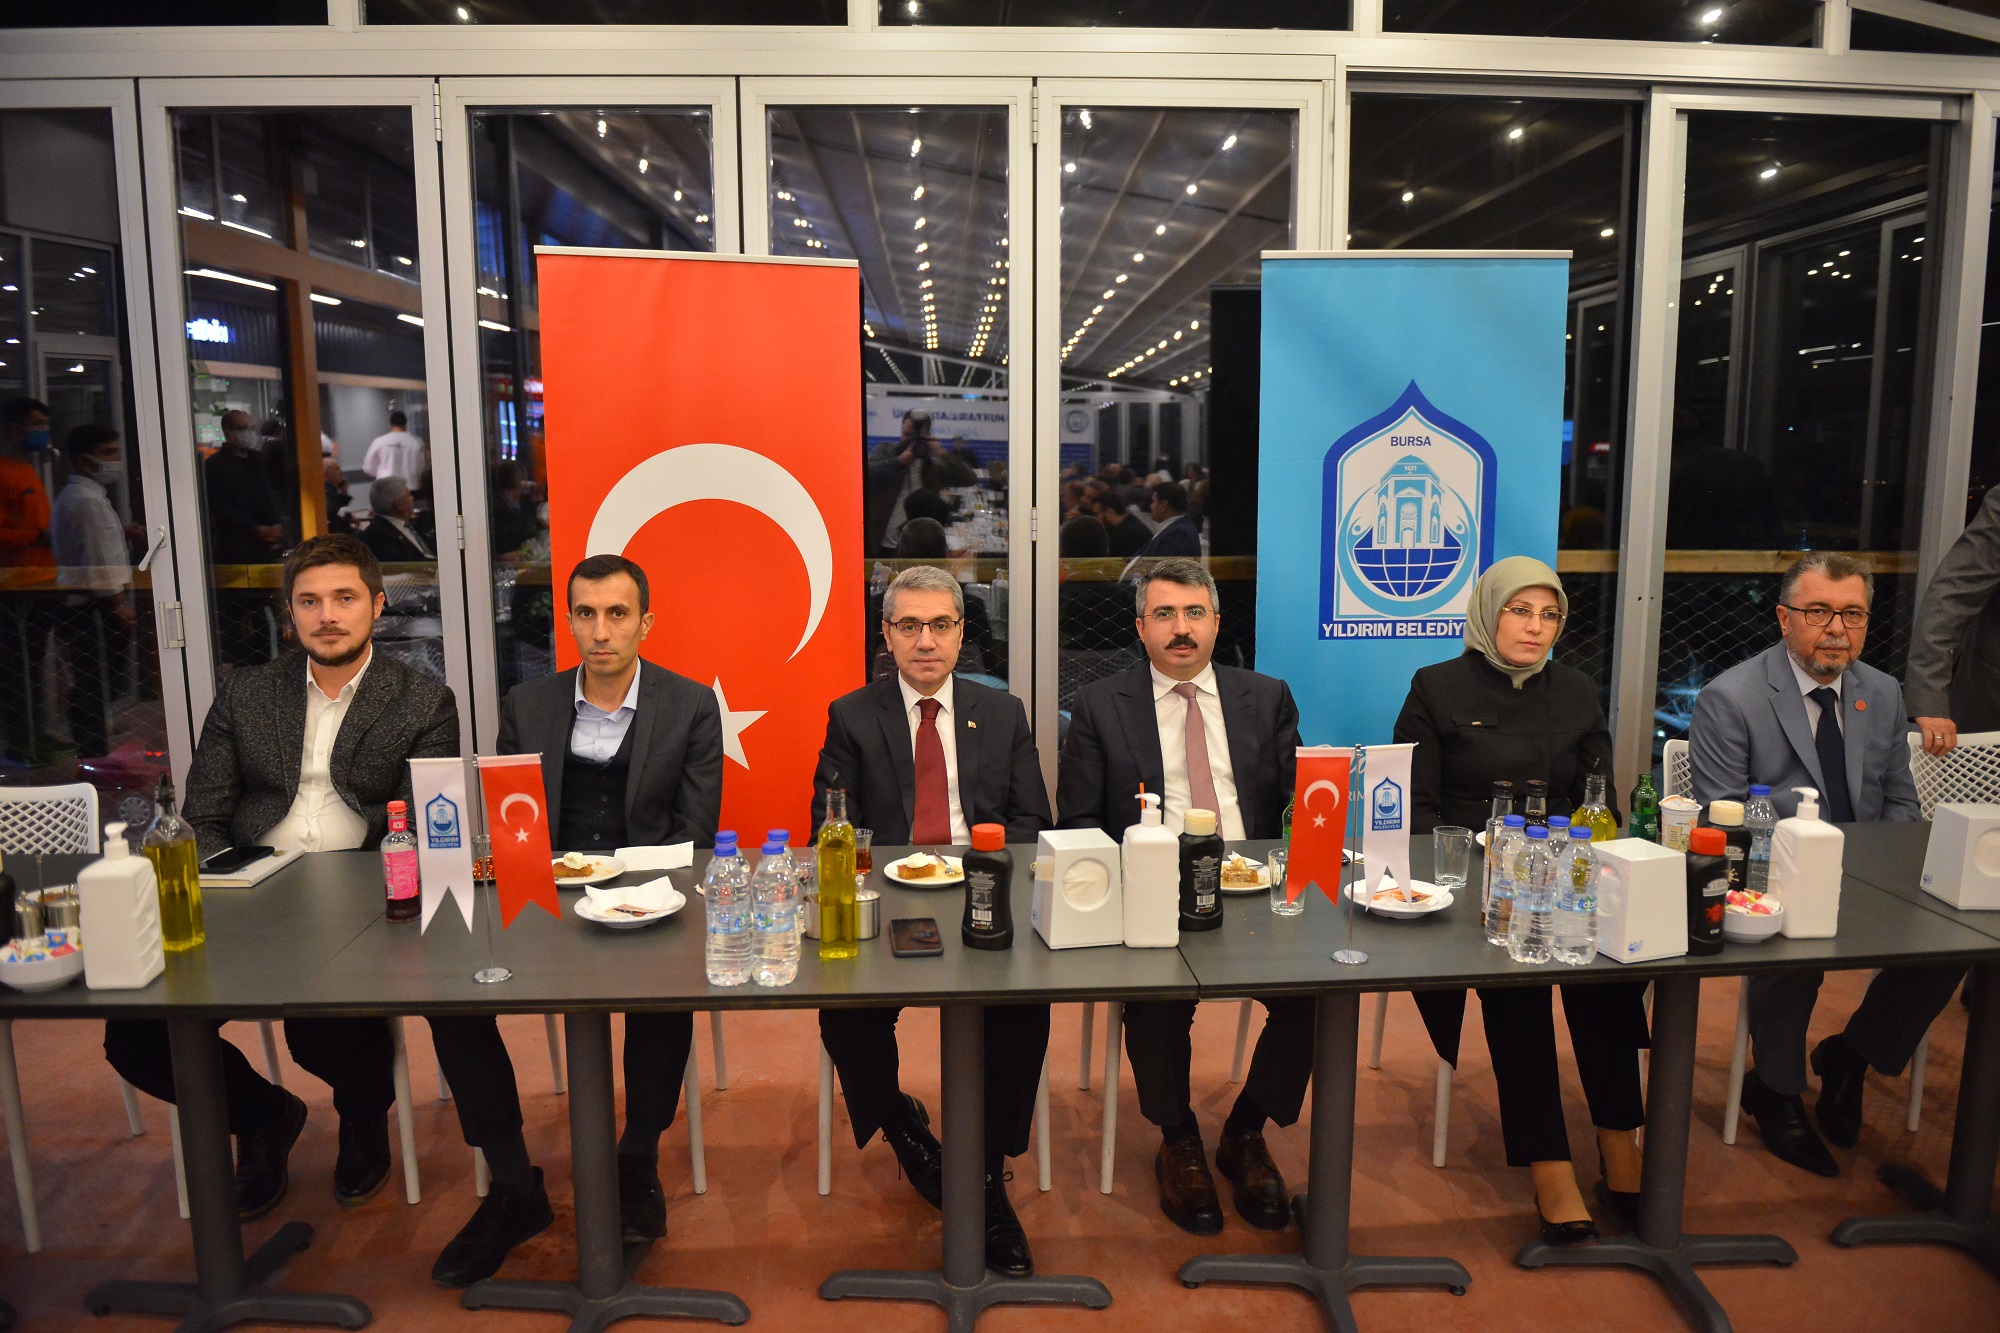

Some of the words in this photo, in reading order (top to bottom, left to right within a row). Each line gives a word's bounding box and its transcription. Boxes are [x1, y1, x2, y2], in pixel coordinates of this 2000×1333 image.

[1390, 436, 1432, 447] BURSA
[1322, 623, 1392, 637] YILDIRIM
[1395, 619, 1466, 636] BELEDİY
